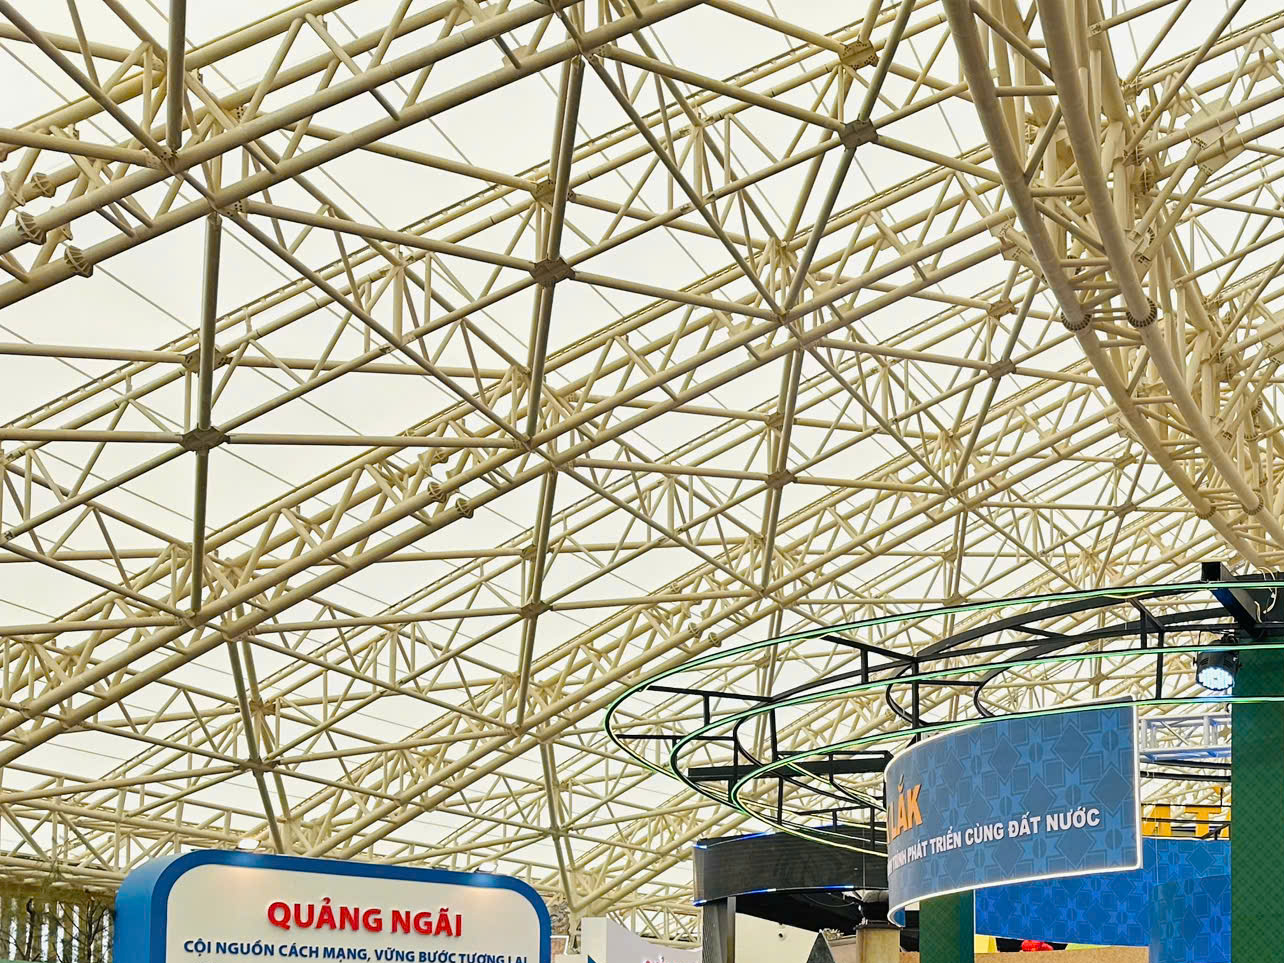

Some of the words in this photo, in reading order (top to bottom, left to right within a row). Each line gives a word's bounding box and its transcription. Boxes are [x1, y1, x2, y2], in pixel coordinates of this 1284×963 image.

[929, 826, 962, 855] TRIỂN
[964, 822, 1004, 846] CÙNG
[1007, 811, 1041, 838] ĐẤT
[1046, 806, 1100, 832] NƯỚC
[267, 897, 383, 933] QUẢNG
[391, 907, 462, 937] NGÃI
[184, 938, 211, 957] CỘI
[278, 943, 319, 959] CÁCH
[322, 946, 371, 962] MẠNG,
[374, 947, 415, 962] VỮNG
[418, 950, 456, 963] BƯỚC
